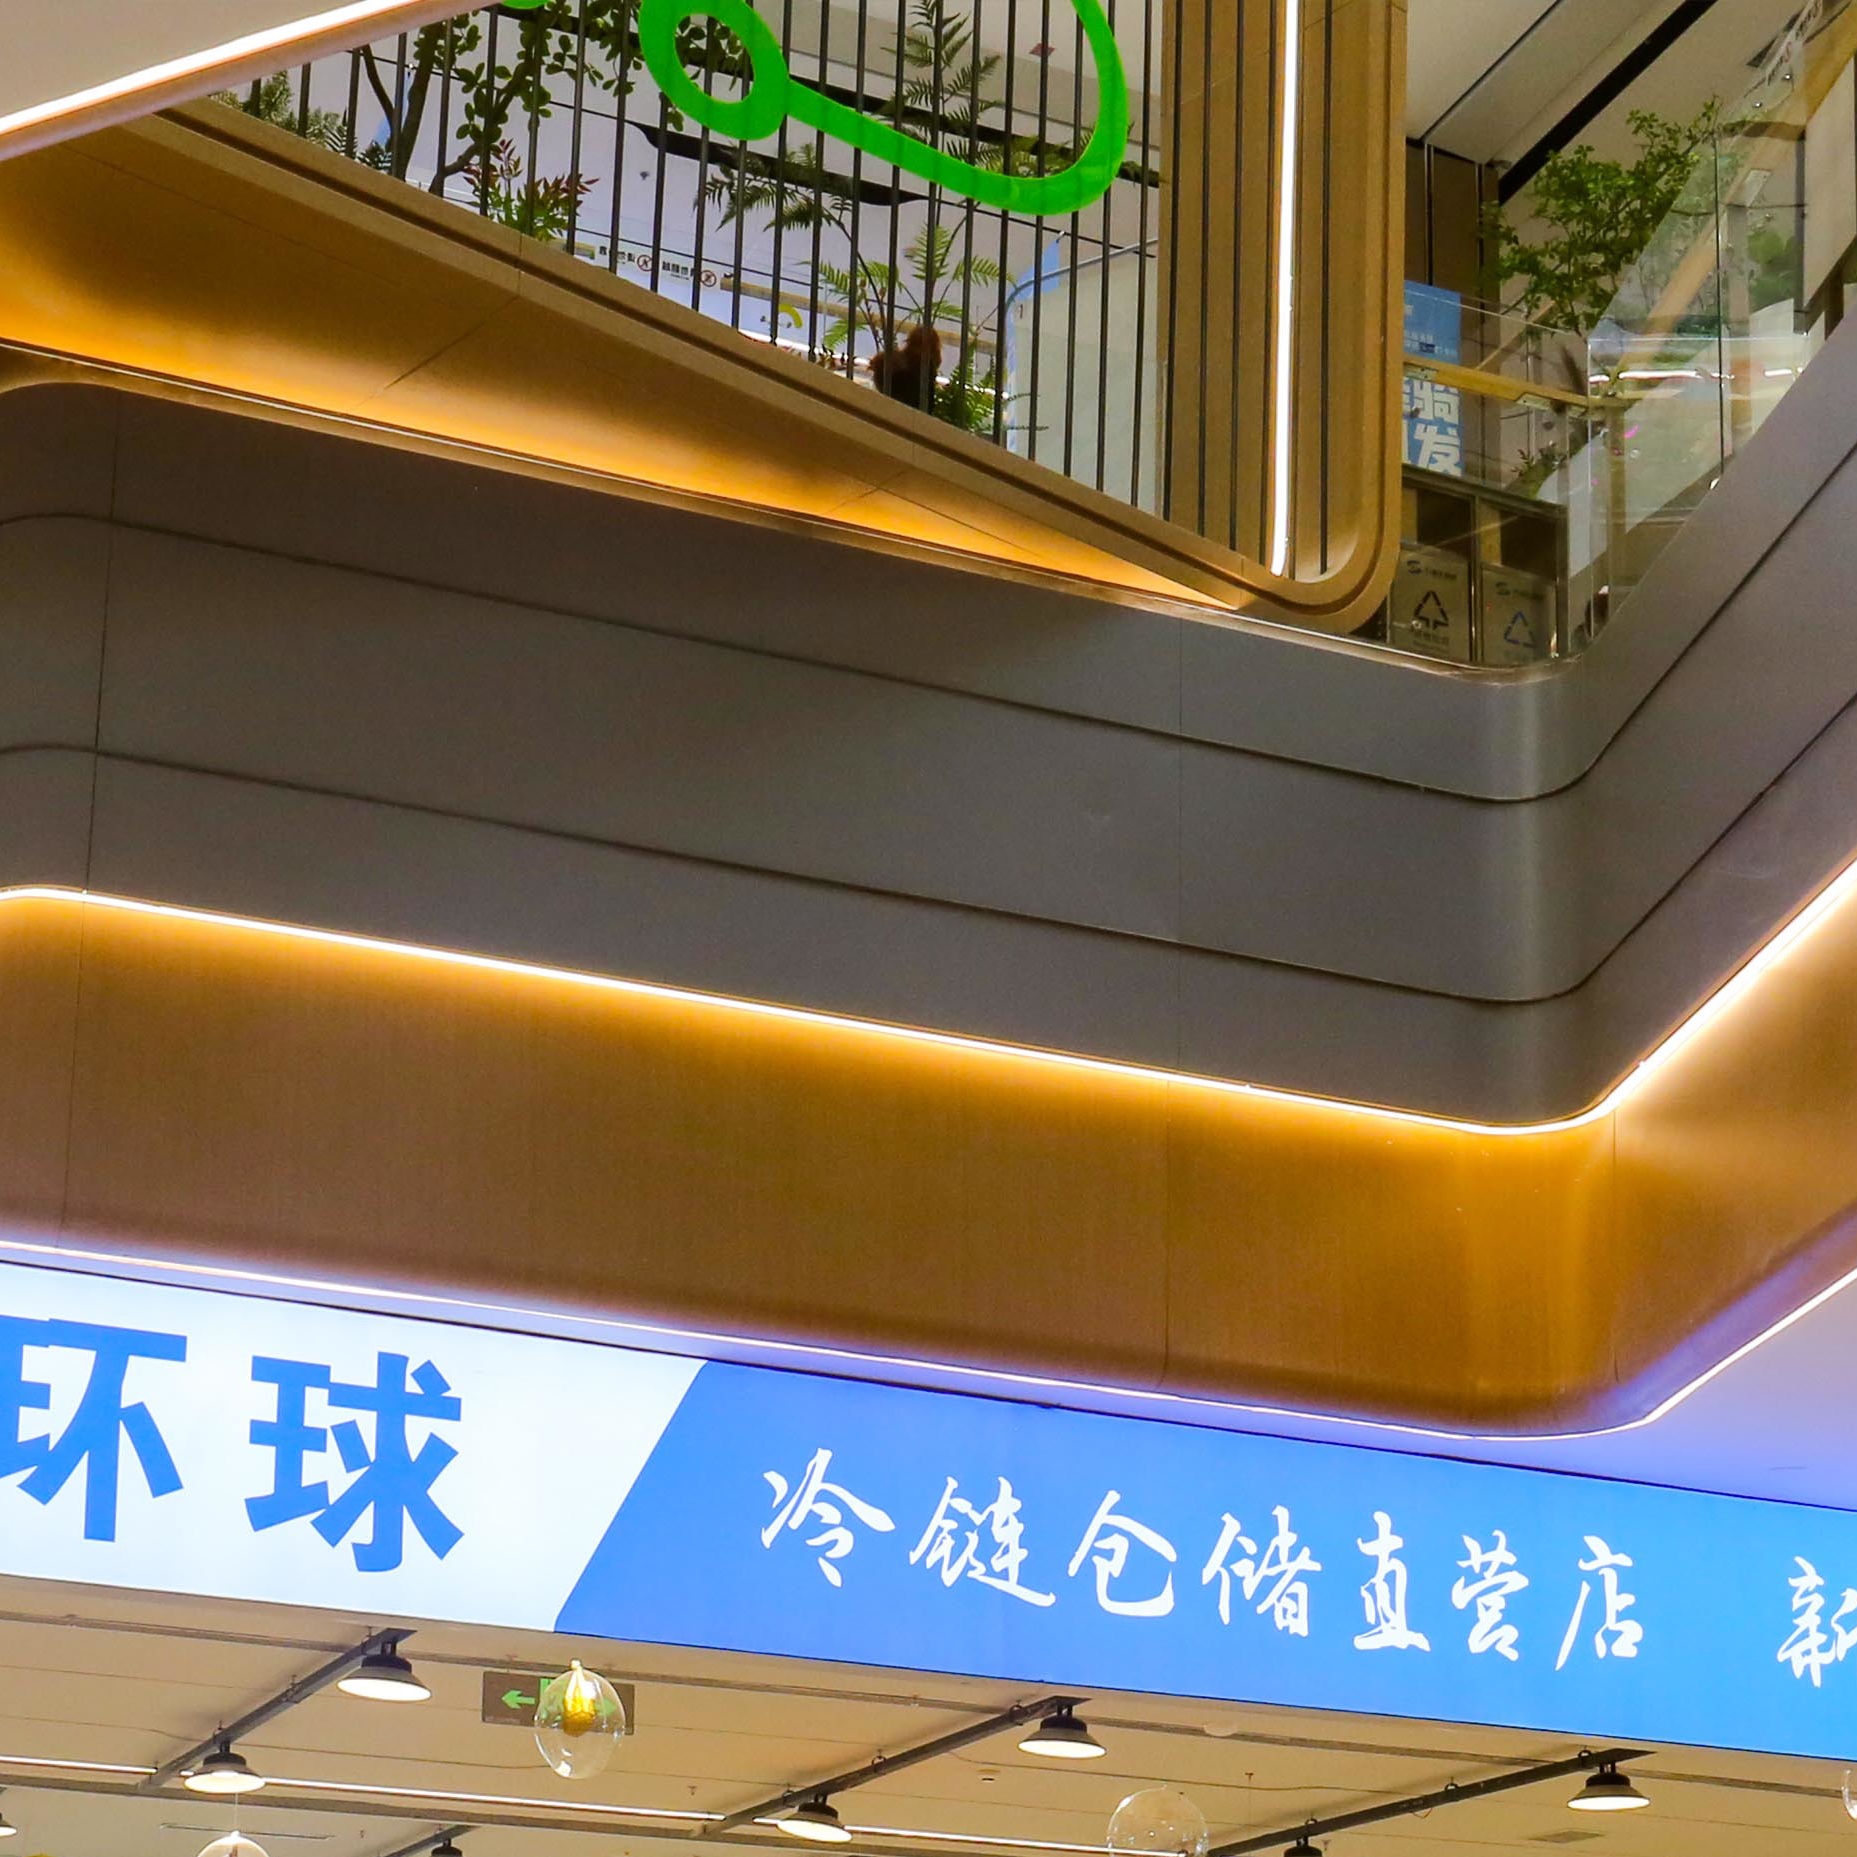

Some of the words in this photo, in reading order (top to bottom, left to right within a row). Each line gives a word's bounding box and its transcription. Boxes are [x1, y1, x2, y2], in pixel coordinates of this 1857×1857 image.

[759, 1446, 1643, 1673] 冷链仓储直营店
